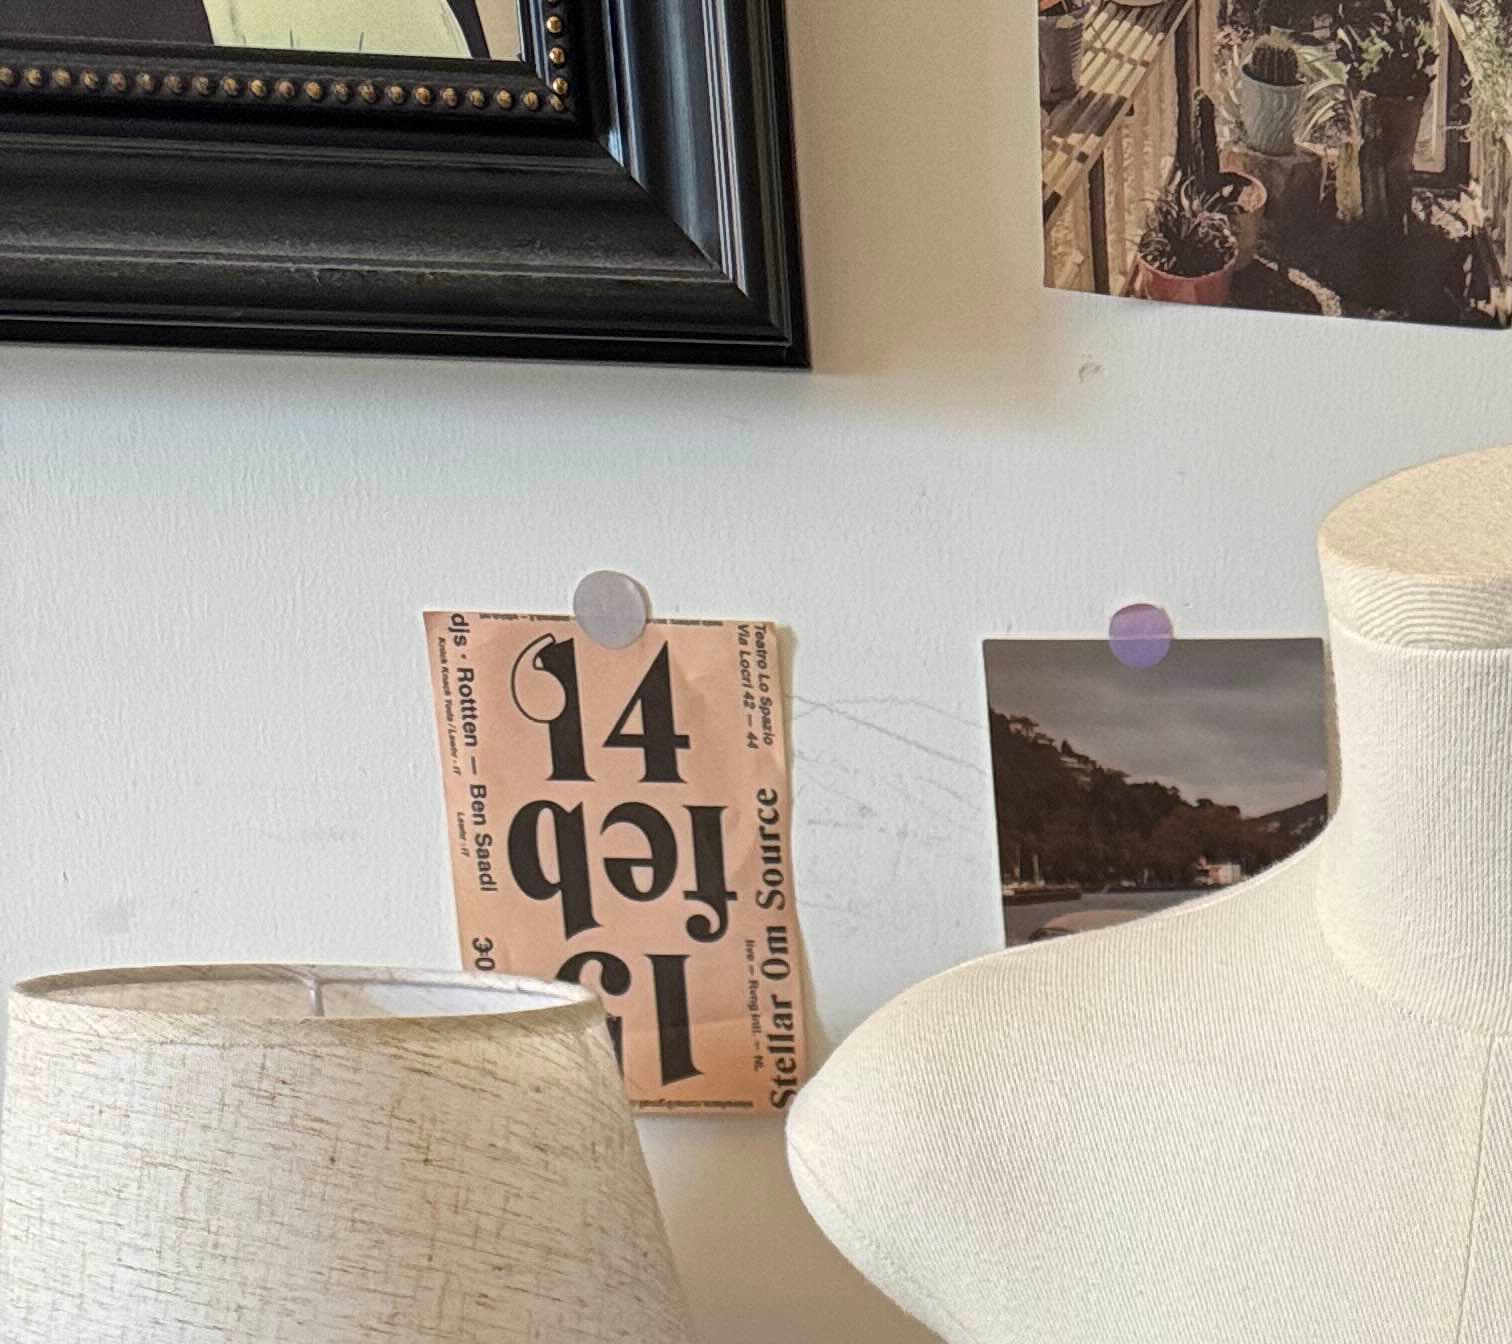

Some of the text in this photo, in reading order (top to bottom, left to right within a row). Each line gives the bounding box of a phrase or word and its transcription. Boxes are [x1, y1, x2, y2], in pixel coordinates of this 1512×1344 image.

[448, 613, 470, 647] djs
[470, 784, 488, 825] Ben
[511, 633, 691, 783] 14
[507, 799, 738, 943] feb
[755, 787, 798, 1110] Stellar Om Source
